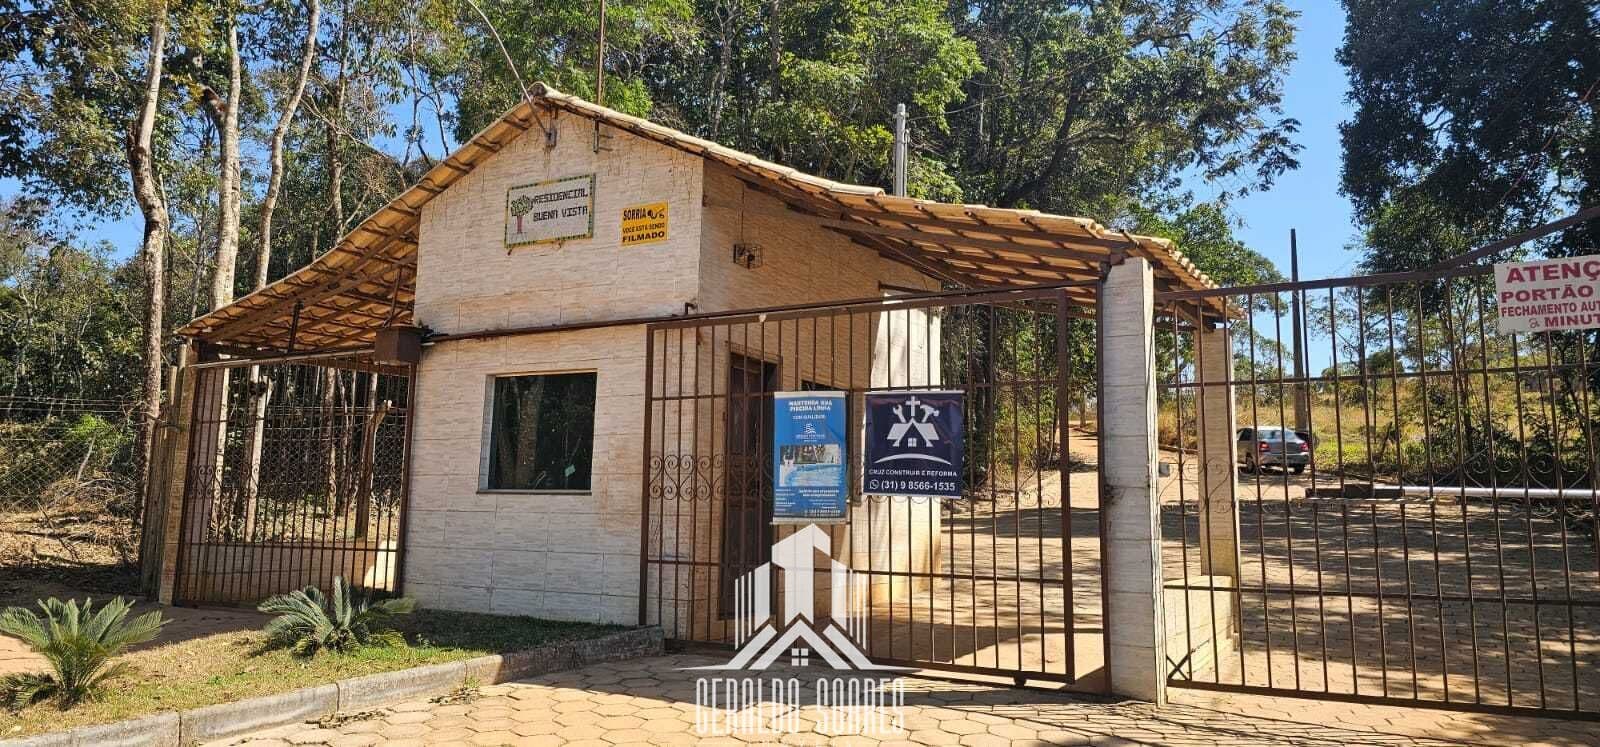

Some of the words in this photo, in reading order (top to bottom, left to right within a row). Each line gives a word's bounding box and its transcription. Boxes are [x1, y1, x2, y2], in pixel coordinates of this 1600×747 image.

[532, 188, 588, 204] RESIDENCIAL
[533, 209, 558, 222] BUENA
[561, 205, 588, 218] VISTA
[623, 208, 647, 221] SORRIA
[622, 231, 665, 242] FILMADO
[1506, 260, 1600, 283] ATENÇ
[1501, 284, 1594, 303] PORTÃO
[1501, 302, 1577, 317] FECHAMENTO
[881, 480, 898, 491] (31)
[900, 481, 906, 490] 9
[908, 481, 956, 491] 8566-1535
